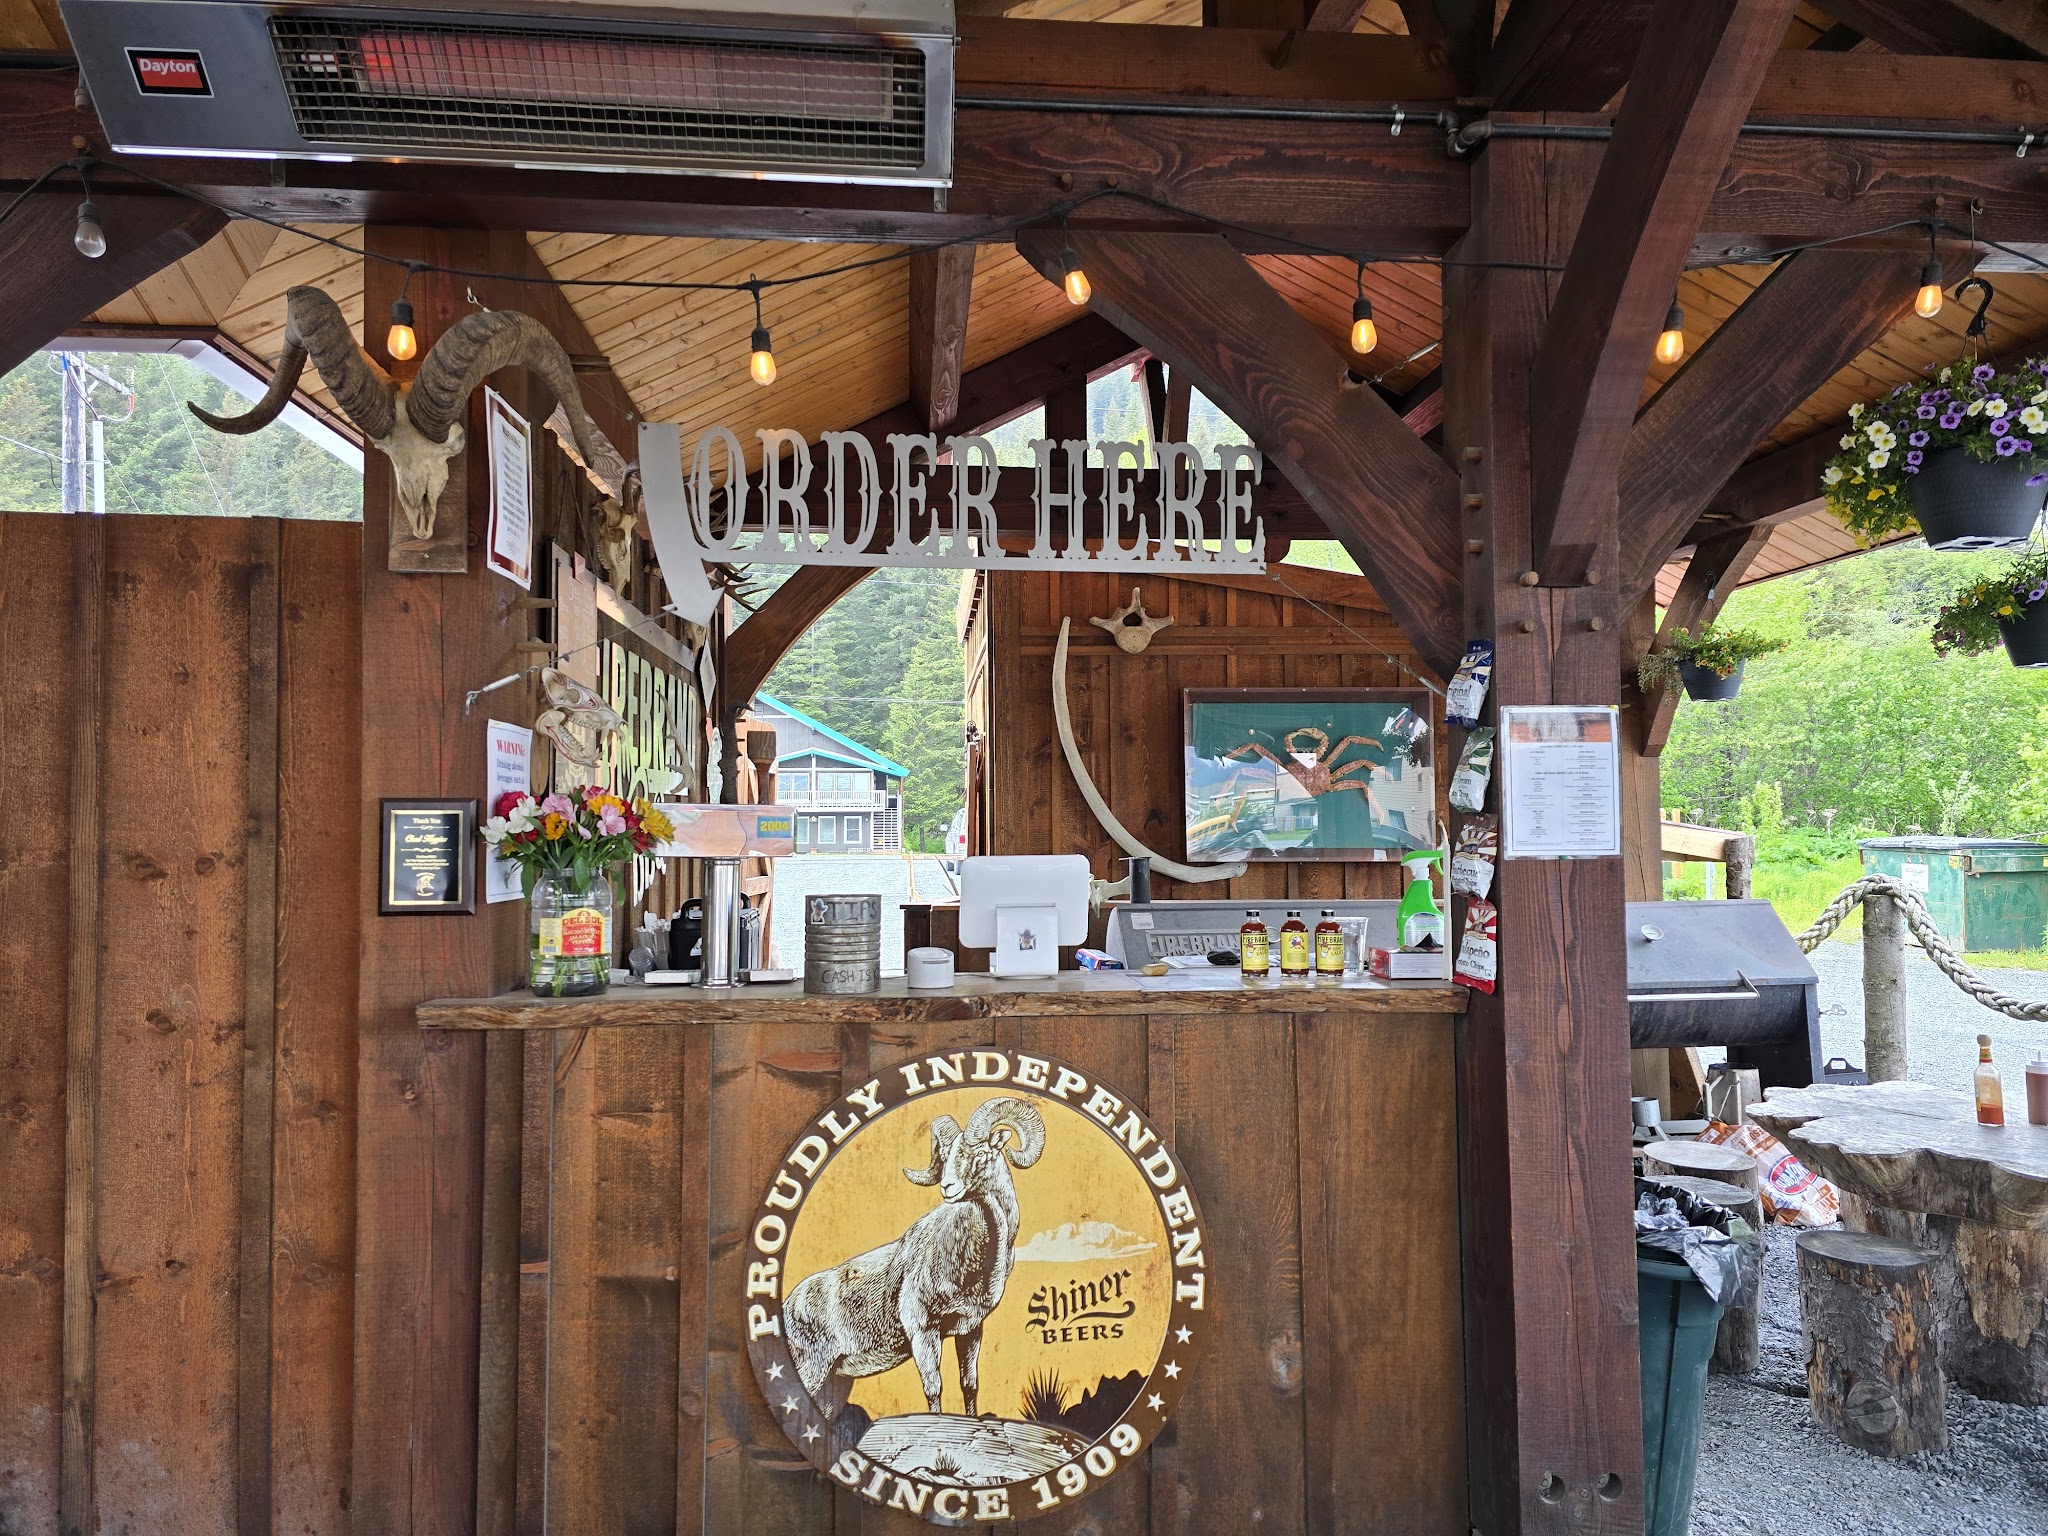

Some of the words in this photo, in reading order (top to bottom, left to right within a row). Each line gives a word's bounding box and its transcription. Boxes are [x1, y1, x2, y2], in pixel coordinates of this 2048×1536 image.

[139, 58, 197, 76] Dayton
[686, 424, 1007, 560] ORDER
[1027, 438, 1268, 563] HERE
[1448, 684, 1472, 697] riginal
[596, 638, 698, 795] IREBRAND
[759, 820, 790, 832] 2004
[562, 915, 584, 926] DEL
[584, 915, 603, 926] SOL
[826, 899, 878, 922] TIPS
[1146, 933, 1241, 957] FIREBRAN
[1461, 940, 1491, 960] alapeño
[821, 968, 856, 984] CASH
[858, 968, 872, 983] IS
[745, 1077, 886, 1342] PROUDLY
[899, 1048, 1207, 1313] INDEPENDENT
[1025, 1266, 1136, 1332] Shiner
[1042, 1322, 1126, 1345] BEERS
[828, 1449, 1011, 1522] SINCE
[1030, 1422, 1144, 1511] 1909
